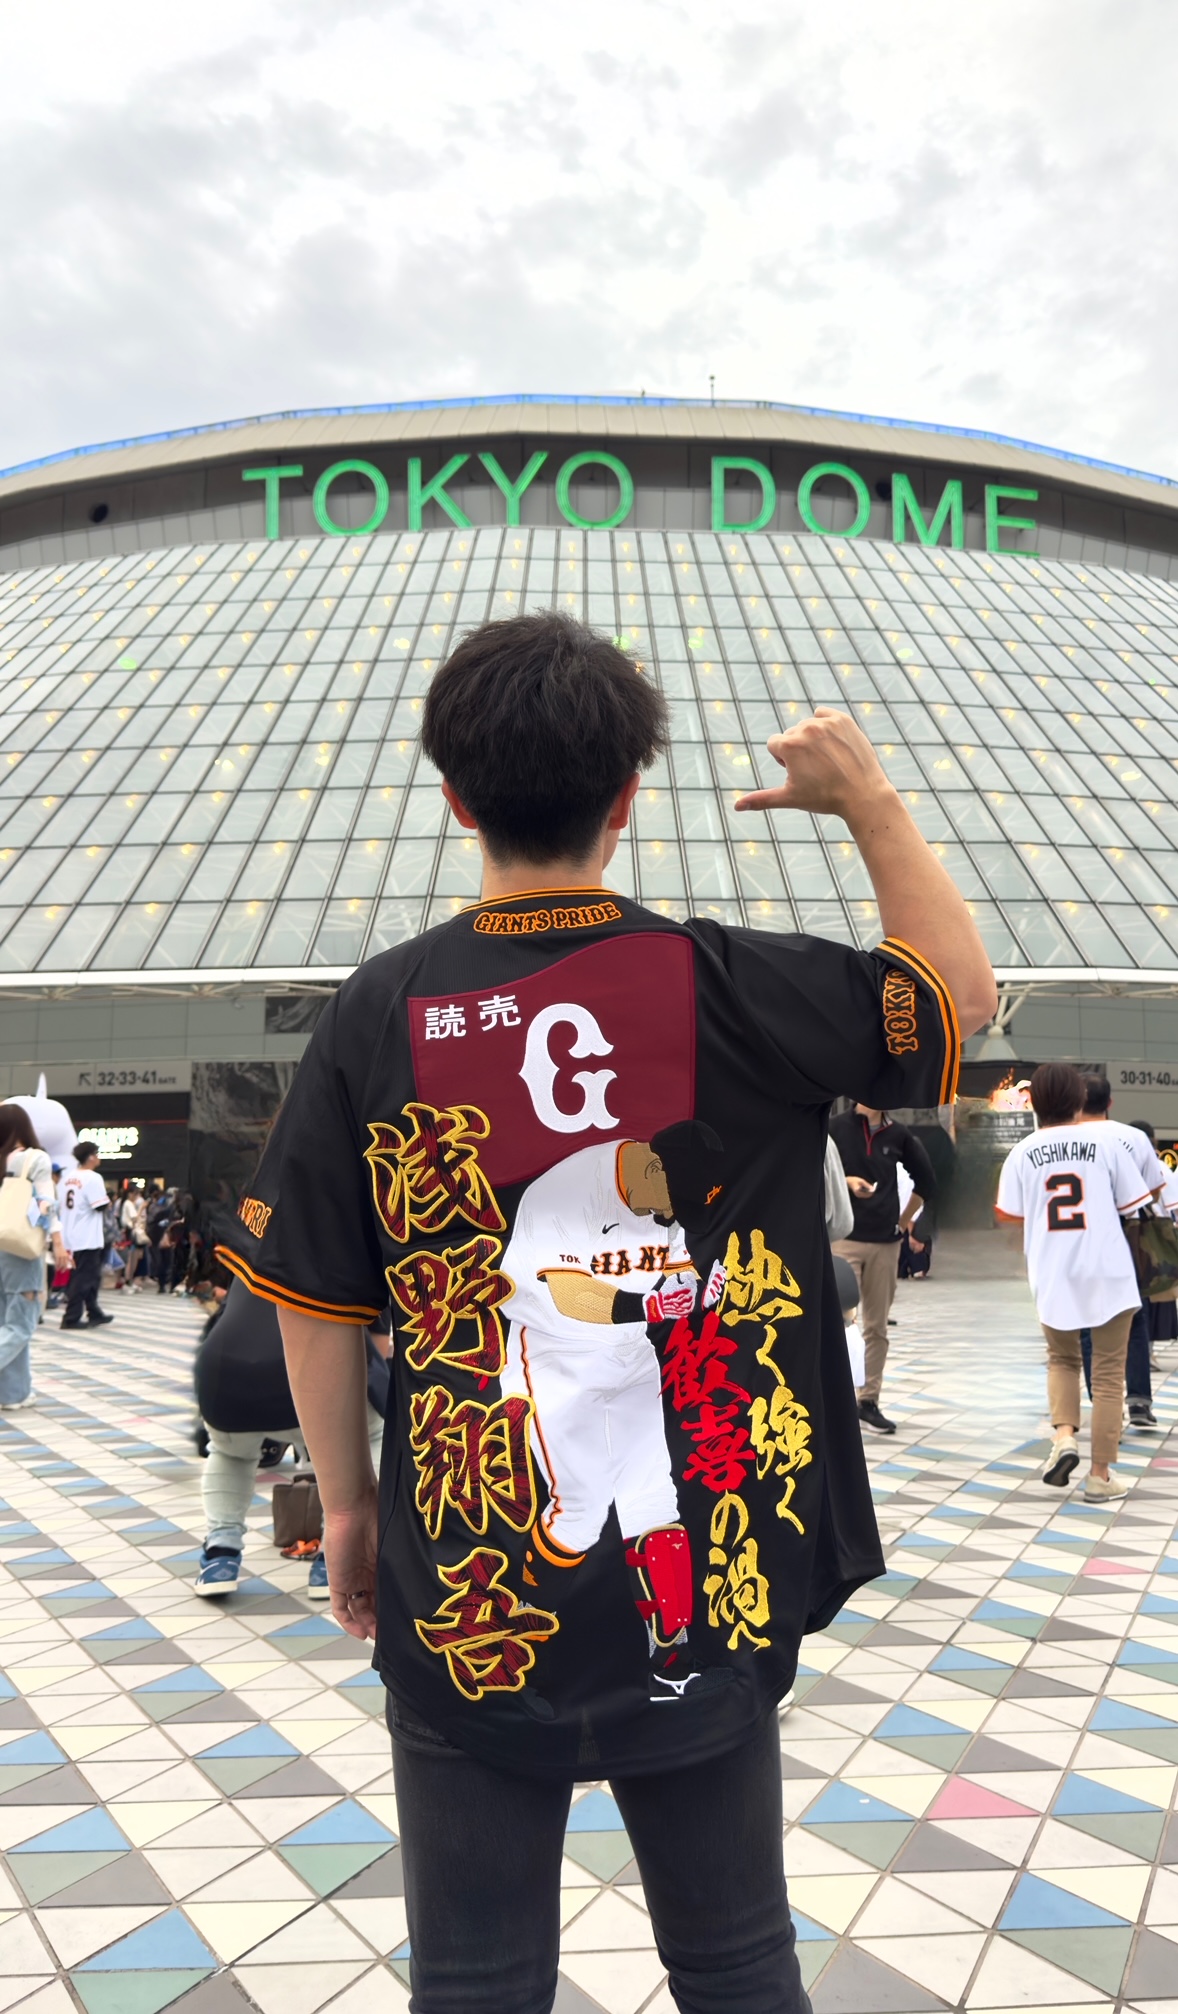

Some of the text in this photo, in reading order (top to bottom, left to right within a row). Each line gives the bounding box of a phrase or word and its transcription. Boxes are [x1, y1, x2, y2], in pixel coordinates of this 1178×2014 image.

[242, 450, 1040, 559] TOKYO DOME
[474, 901, 622, 935] GIANTS PRIDE
[425, 994, 522, 1041] 読売
[518, 1002, 621, 1134] G
[1026, 1141, 1096, 1169] YOSHIKAWA
[66, 1189, 75, 1209] 6
[1045, 1172, 1087, 1232] 2
